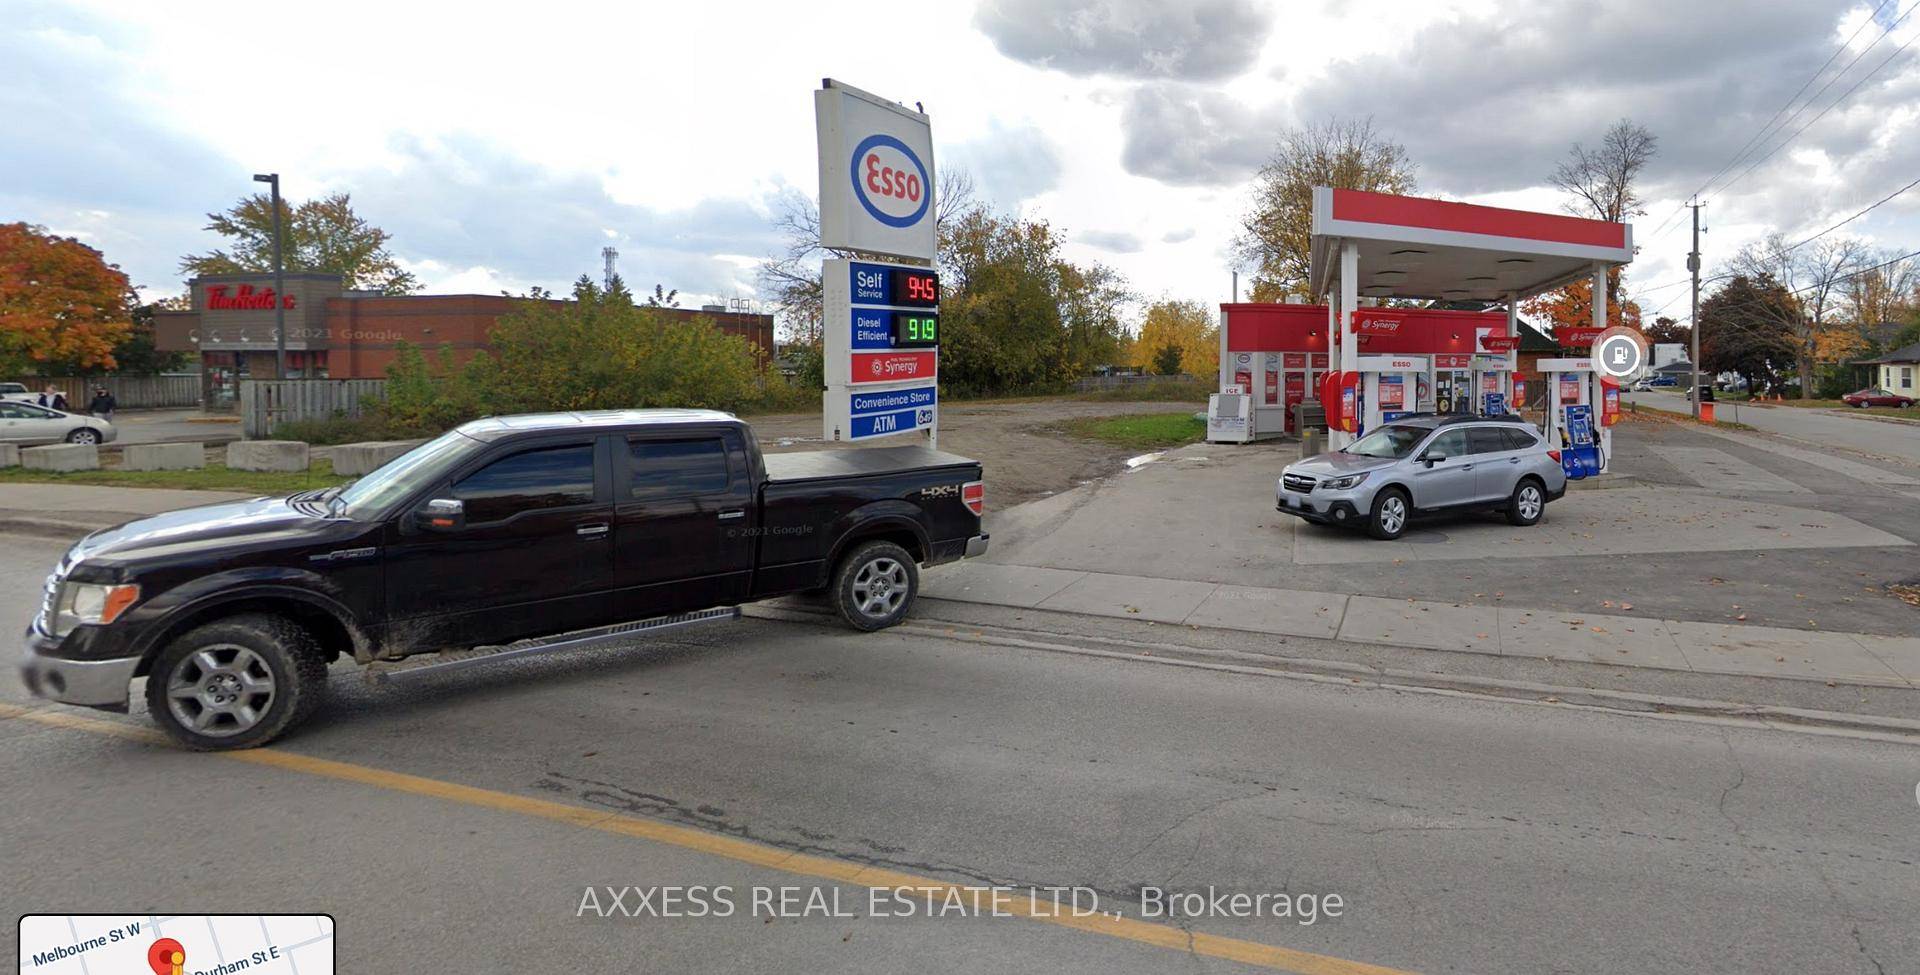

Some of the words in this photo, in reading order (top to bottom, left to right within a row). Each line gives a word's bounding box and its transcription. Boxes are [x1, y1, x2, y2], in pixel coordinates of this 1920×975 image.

[857, 271, 882, 288] Self
[235, 283, 296, 311] Hortos
[857, 288, 883, 299] Service
[857, 317, 881, 328] Diesel
[1372, 320, 1399, 331] Synergy
[857, 330, 888, 341] Efficient
[885, 360, 918, 375] Synergy
[854, 395, 909, 410] Convenience
[910, 392, 931, 403] Store
[873, 415, 897, 433] ATM
